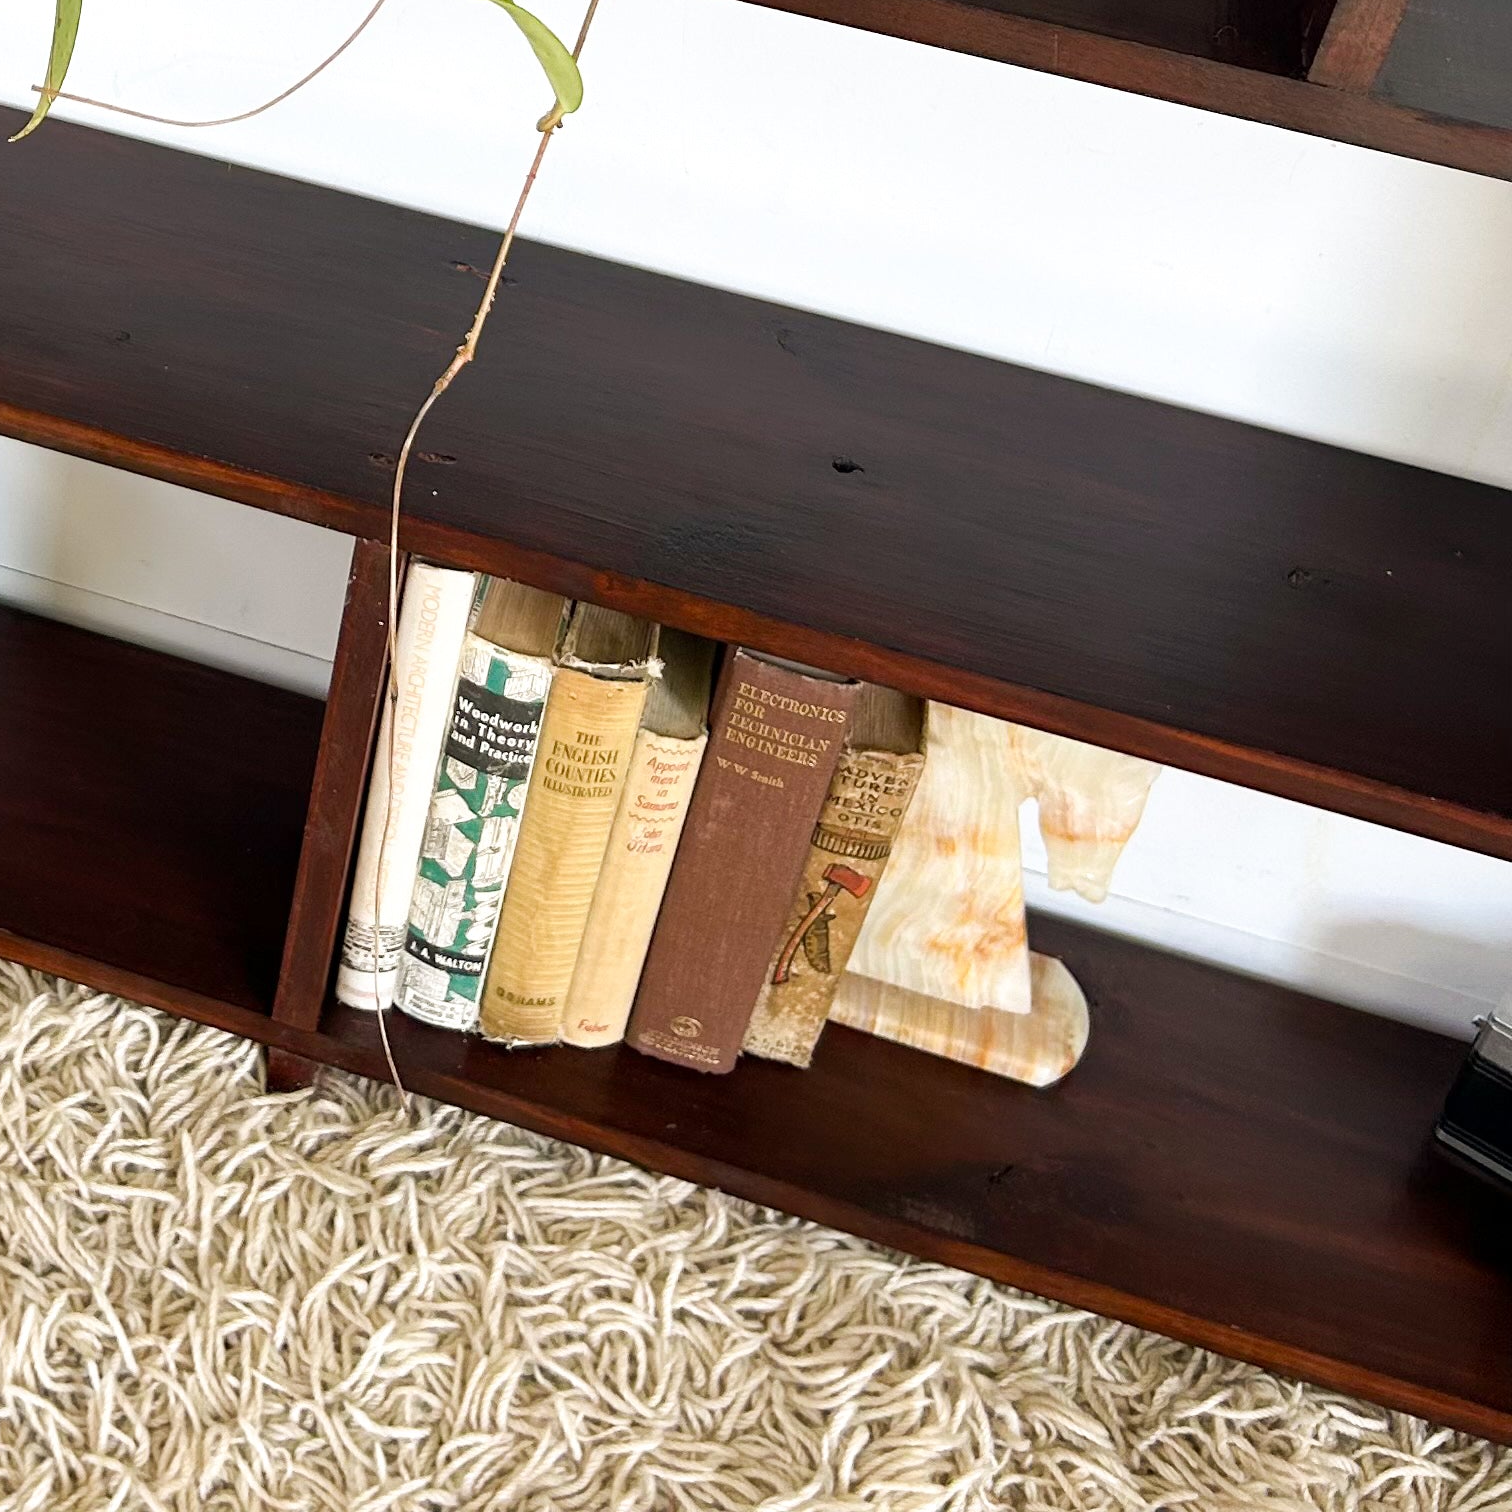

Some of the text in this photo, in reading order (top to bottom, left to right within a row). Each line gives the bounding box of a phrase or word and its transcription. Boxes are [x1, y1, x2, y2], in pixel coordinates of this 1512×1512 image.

[413, 584, 443, 651] MODERN
[395, 654, 429, 761] ARCHITECTURE
[458, 696, 539, 734] Woodwork
[734, 697, 767, 720] FOR
[738, 681, 848, 724] ELECTRONICS
[454, 711, 535, 752] in Theory
[576, 731, 604, 747] THE
[728, 711, 831, 752] TECHNICIAN
[450, 730, 533, 764] and Practice
[552, 740, 619, 766] ENGLISH
[725, 726, 819, 768] ENGINEERS
[545, 756, 617, 783] COUNTIES
[750, 770, 785, 788] Smith
[543, 776, 613, 798] ILLUSTRATED
[840, 774, 906, 797] TURES
[859, 791, 880, 804] IN
[828, 793, 902, 817] MEXICO
[837, 813, 882, 829] OTIS
[434, 954, 483, 972] WALTON
